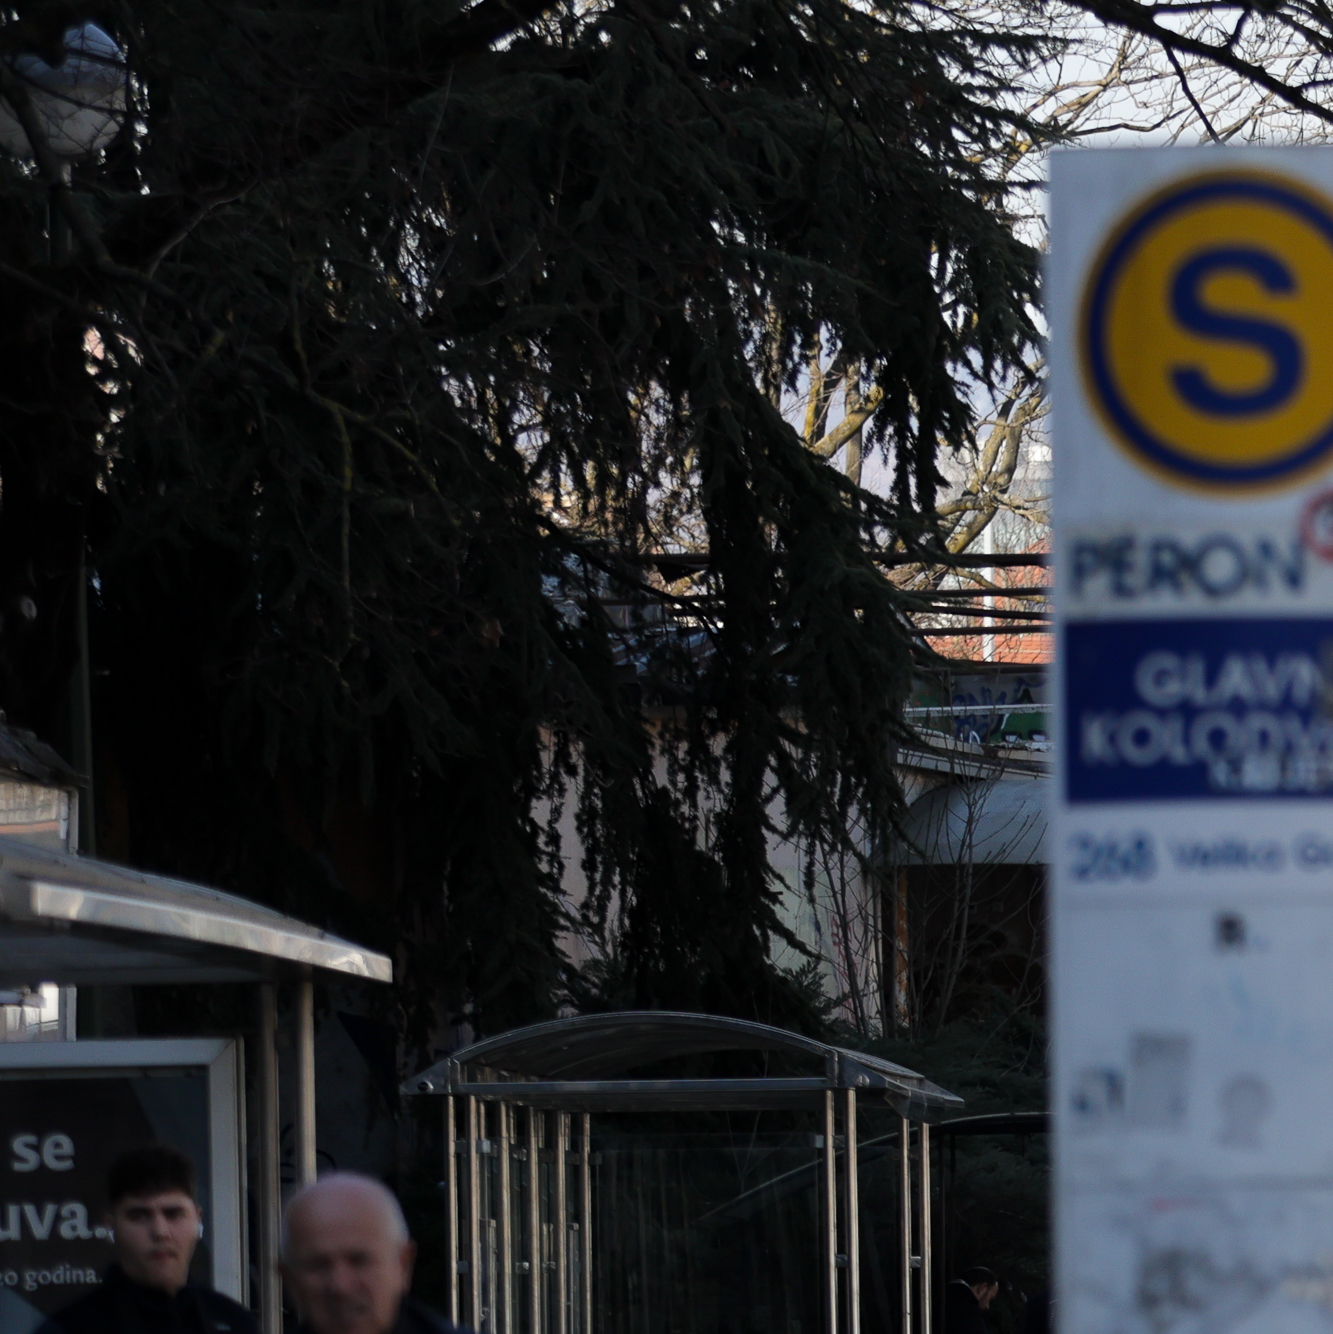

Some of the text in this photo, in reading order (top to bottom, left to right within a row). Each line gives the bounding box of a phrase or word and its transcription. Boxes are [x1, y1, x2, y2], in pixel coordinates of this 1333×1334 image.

[1165, 242, 1308, 420] S
[1070, 532, 1305, 602] PERON
[1133, 650, 1330, 708] GLAVN
[12, 1133, 76, 1173] se
